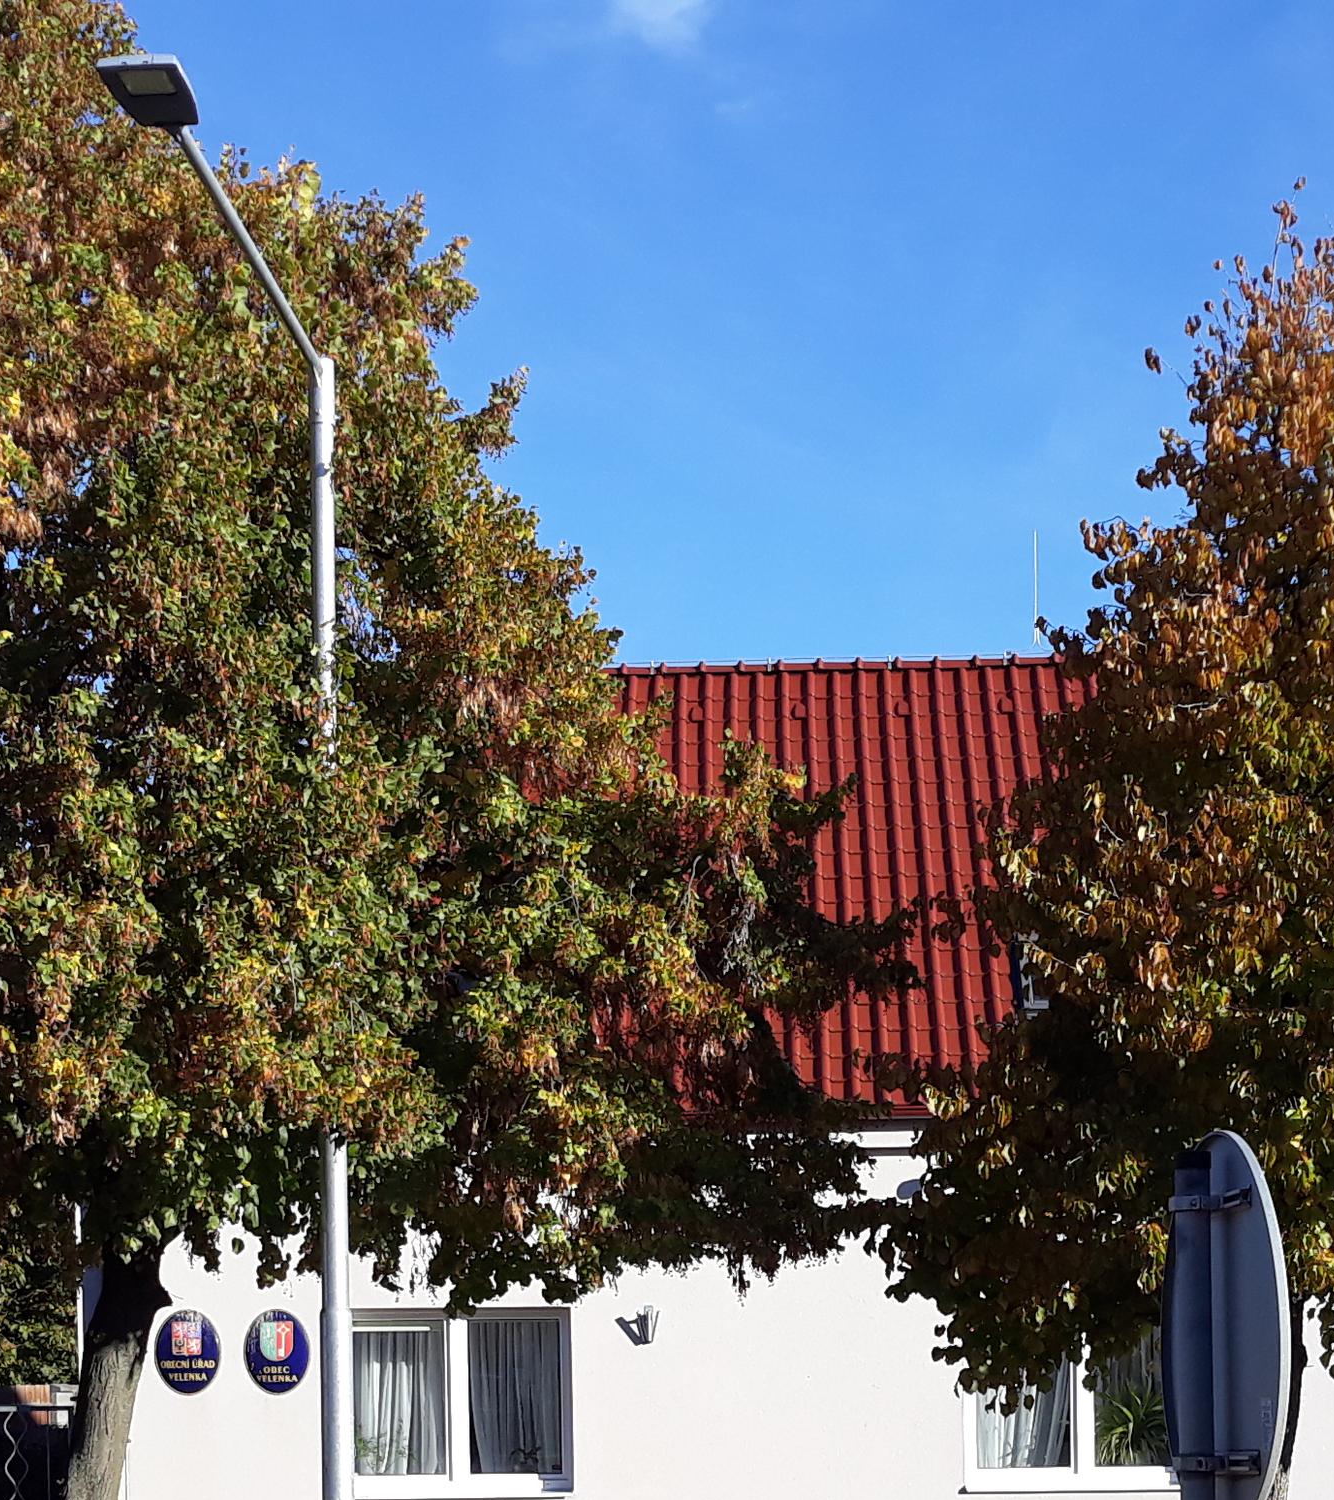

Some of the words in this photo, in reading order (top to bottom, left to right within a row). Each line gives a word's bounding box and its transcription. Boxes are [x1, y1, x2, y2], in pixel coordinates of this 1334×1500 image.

[160, 1358, 189, 1369] OBECNÍ
[192, 1358, 215, 1369] ÚŘAD
[263, 1365, 291, 1374] OBEC
[169, 1372, 208, 1382] VELENKA
[256, 1374, 299, 1383] VELENKA
